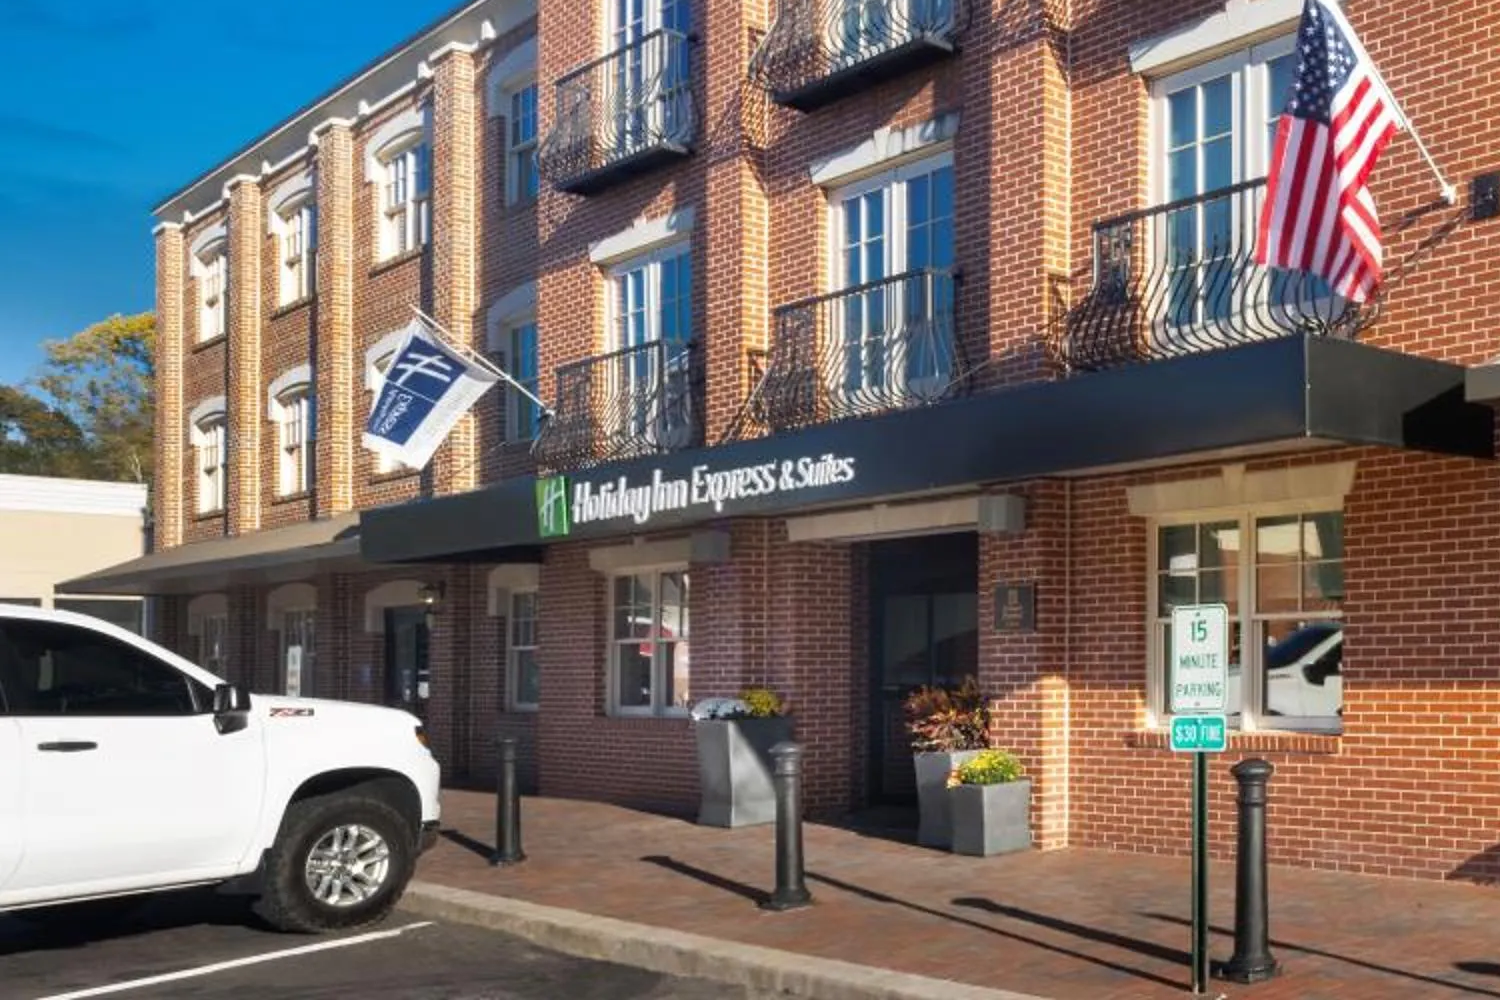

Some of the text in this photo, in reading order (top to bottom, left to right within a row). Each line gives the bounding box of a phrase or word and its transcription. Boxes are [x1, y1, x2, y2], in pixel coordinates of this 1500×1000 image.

[572, 453, 855, 525] Holiday Inn Express & Suites
[1190, 620, 1208, 642] 15
[1179, 653, 1218, 669] MINUTE
[1175, 682, 1222, 697] PARKING
[1175, 724, 1197, 744] $30
